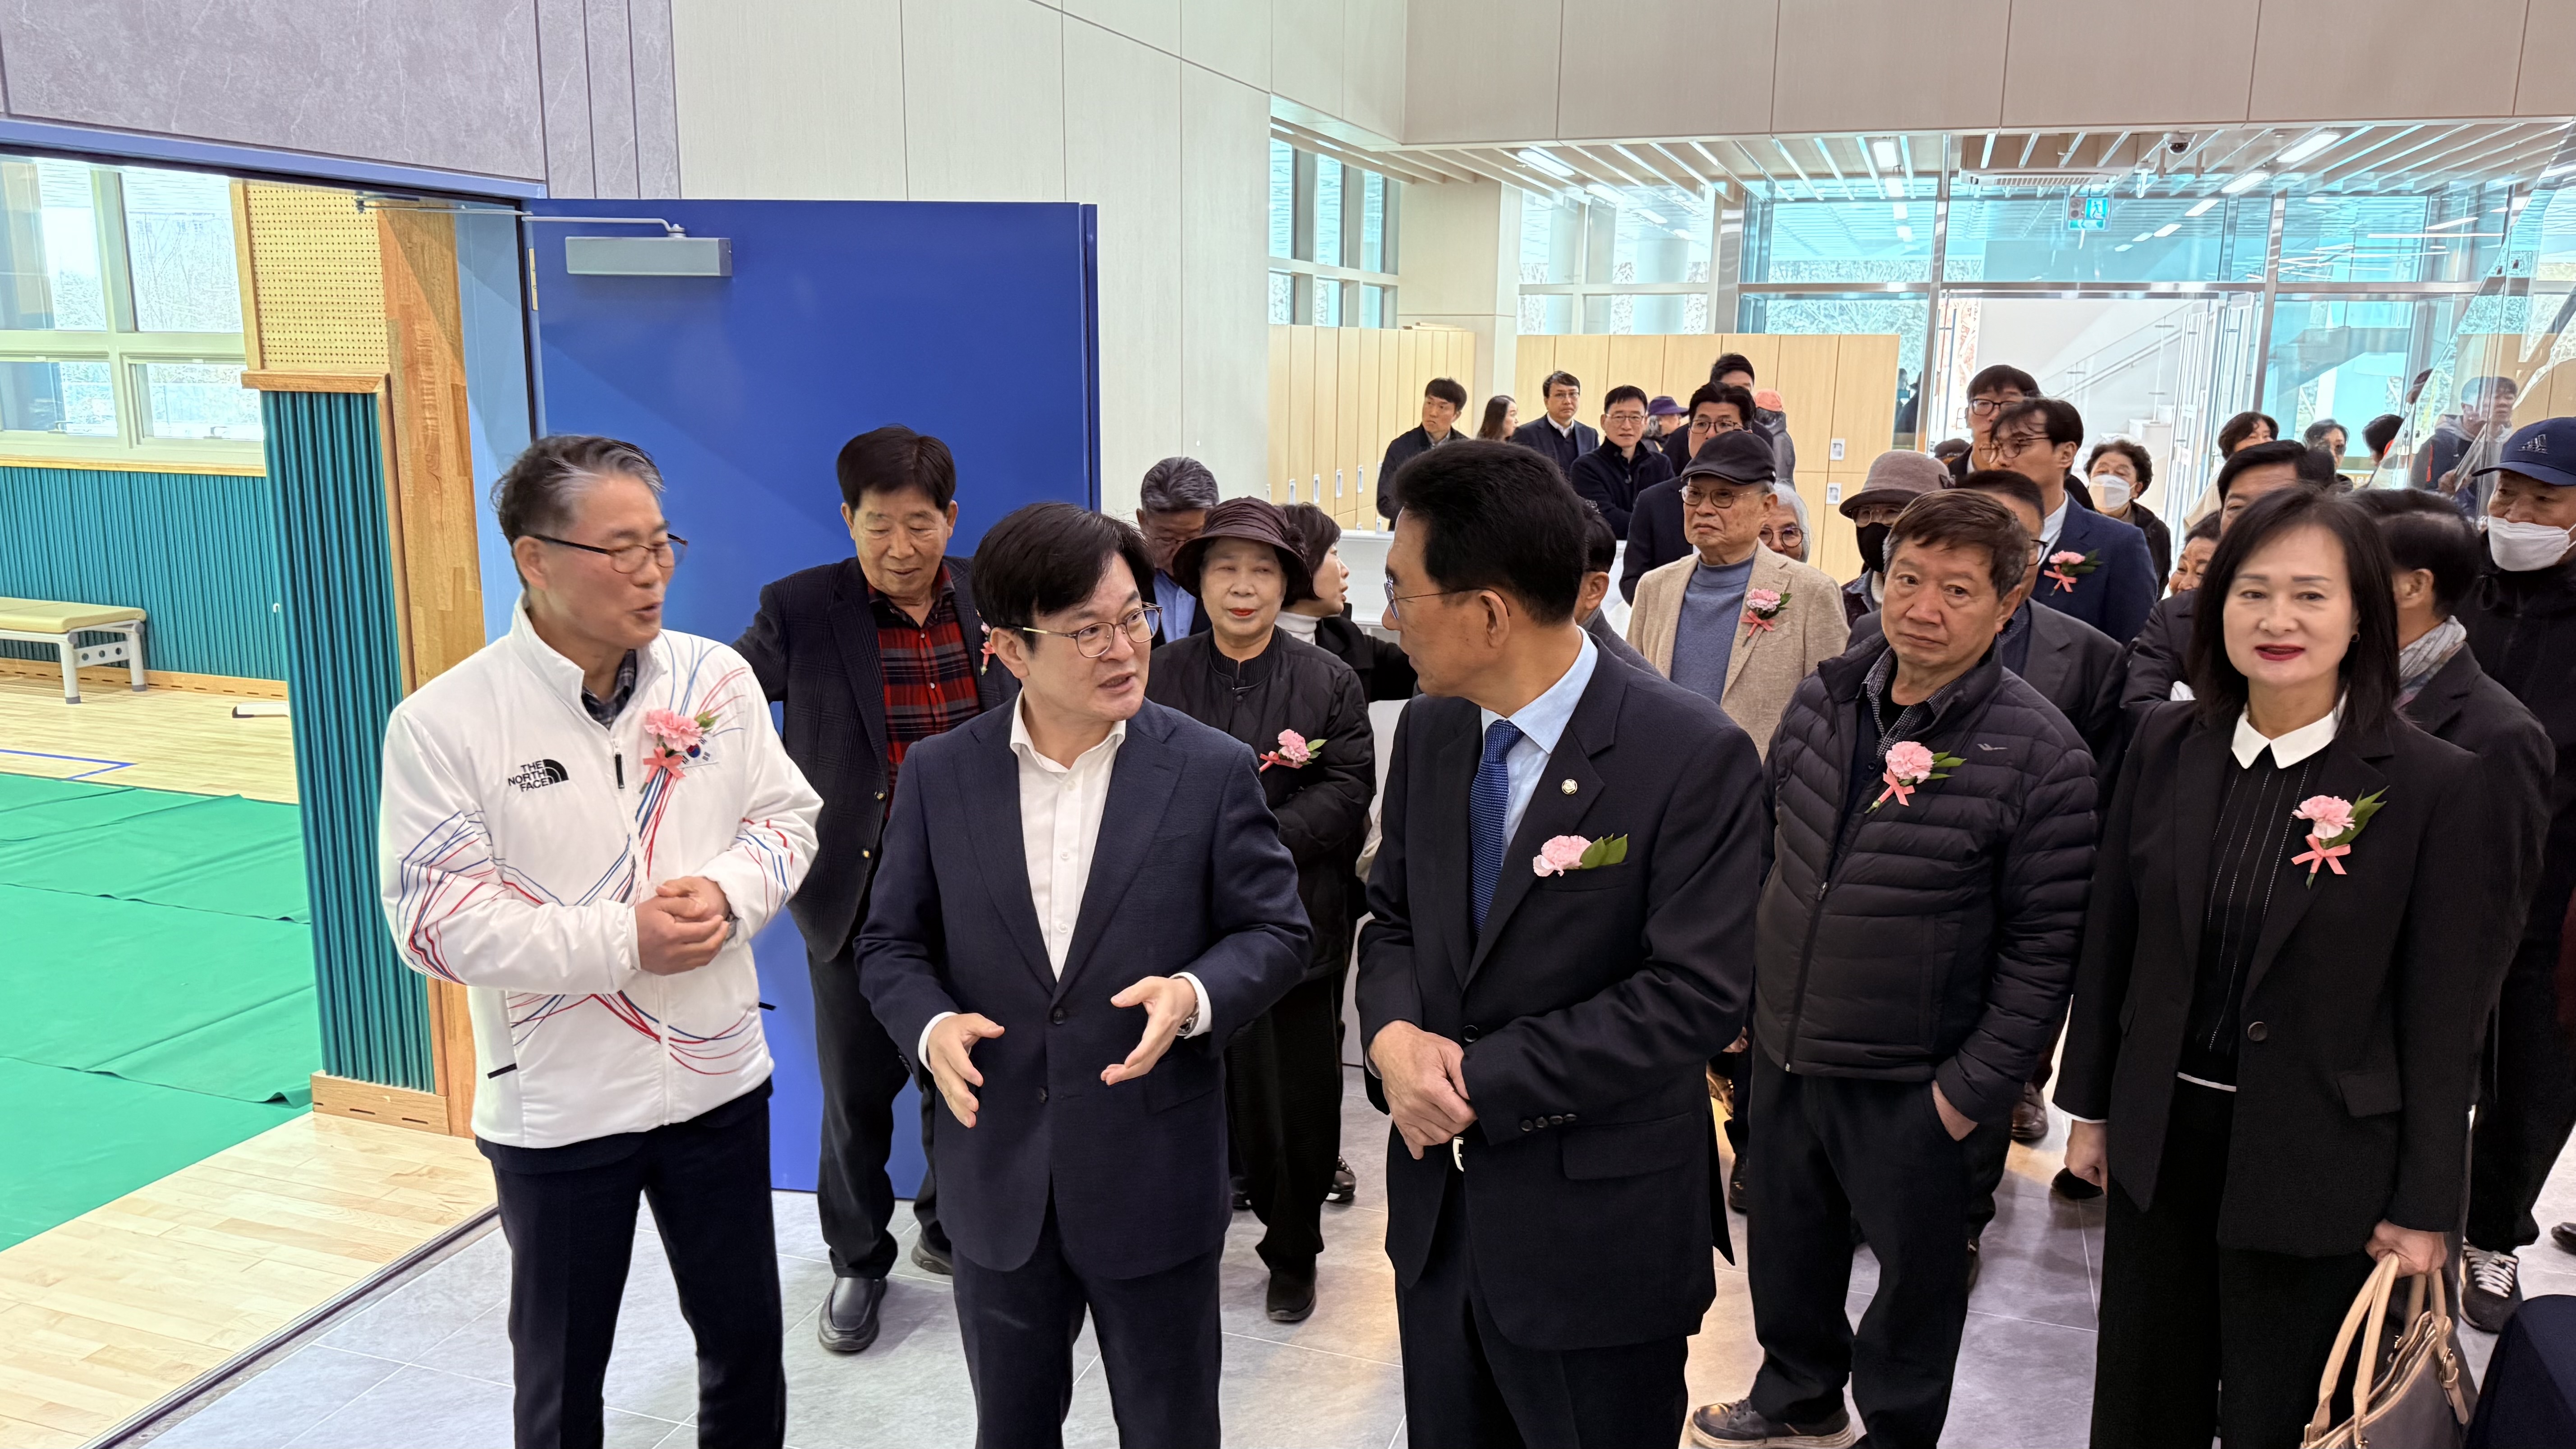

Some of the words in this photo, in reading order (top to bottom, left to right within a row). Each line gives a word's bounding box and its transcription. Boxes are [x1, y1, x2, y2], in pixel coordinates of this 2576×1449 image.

[520, 760, 543, 773] THE
[508, 769, 546, 786] NORTH
[520, 778, 549, 792] FACE
